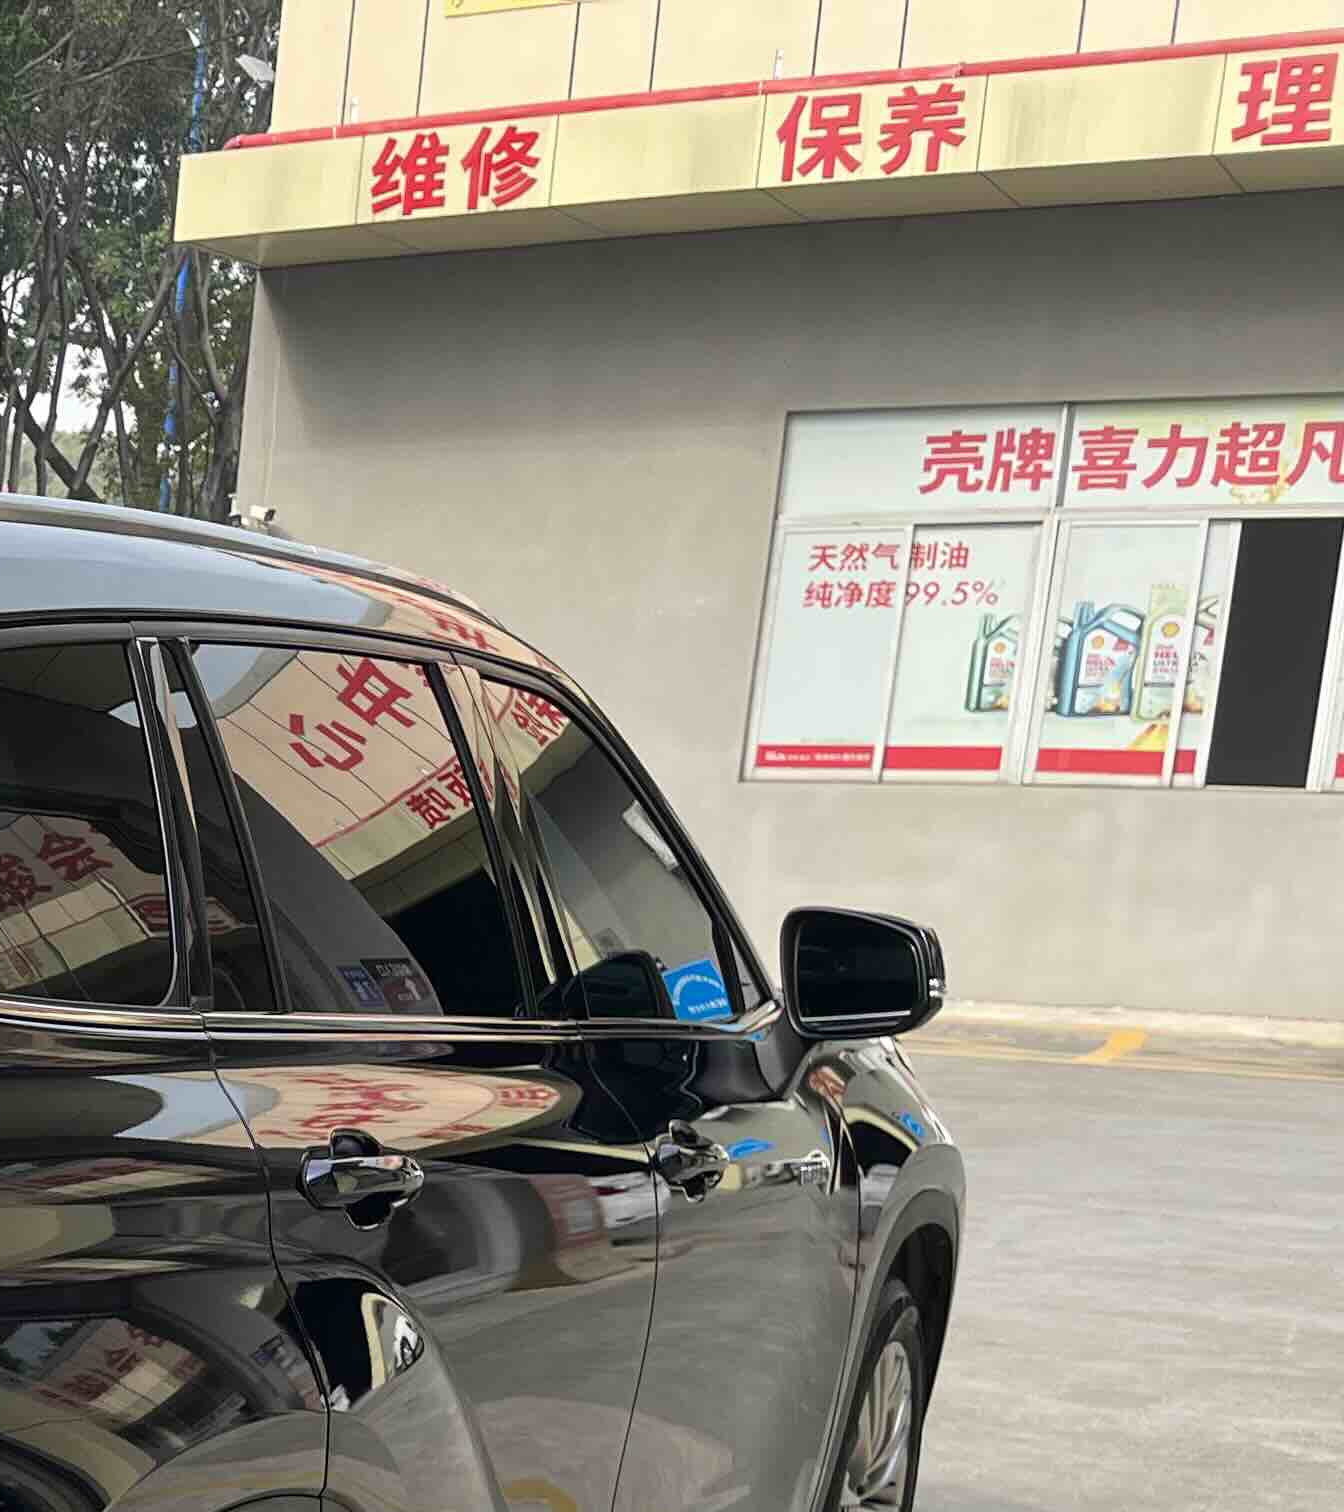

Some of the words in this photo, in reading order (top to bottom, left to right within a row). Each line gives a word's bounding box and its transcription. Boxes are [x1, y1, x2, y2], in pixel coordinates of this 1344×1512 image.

[370, 125, 541, 216] 维修
[776, 82, 967, 182] 保养
[1231, 52, 1339, 147] 理
[807, 542, 970, 572] 天然气制油
